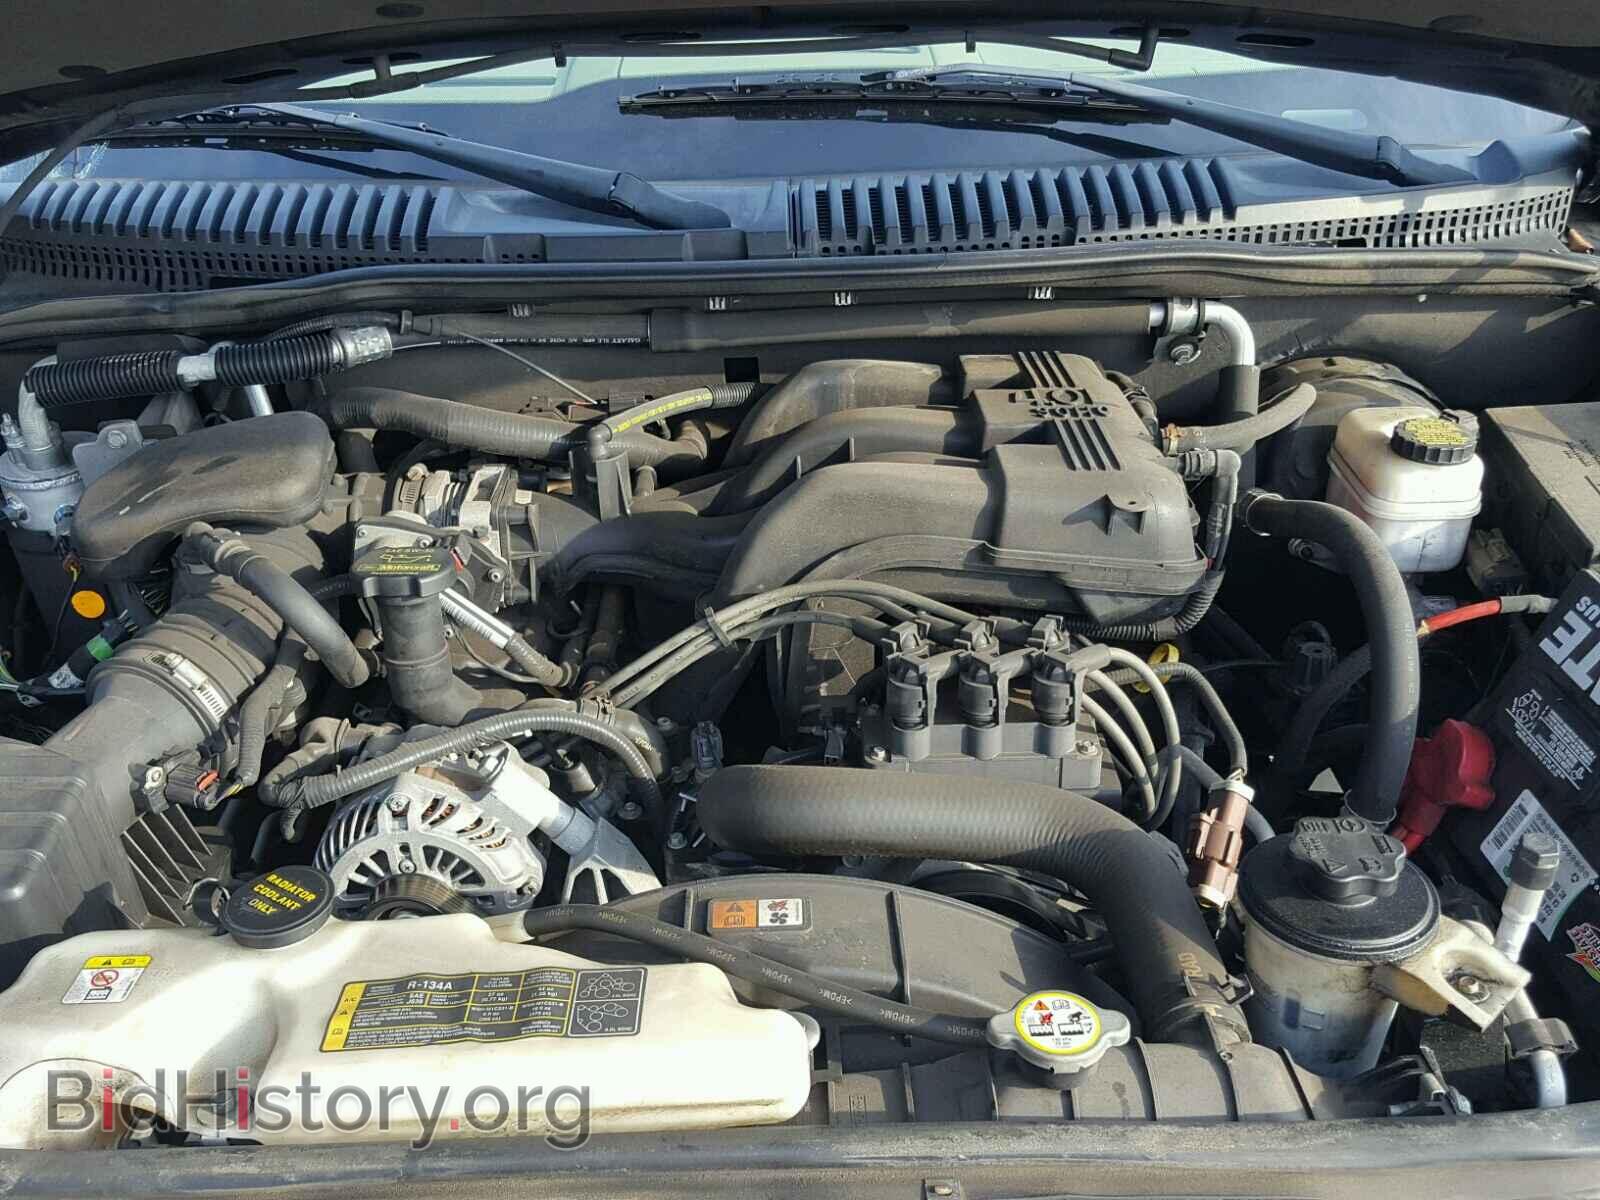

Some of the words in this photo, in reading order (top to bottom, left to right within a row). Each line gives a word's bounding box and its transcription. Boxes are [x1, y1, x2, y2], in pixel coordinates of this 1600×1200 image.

[265, 873, 318, 902] RADIATOR
[247, 898, 278, 915] ONLY
[253, 884, 302, 911] COOLANT
[407, 979, 453, 991] R-134A
[818, 987, 853, 1006] >EPDM<
[879, 1007, 917, 1025] >EPDM<
